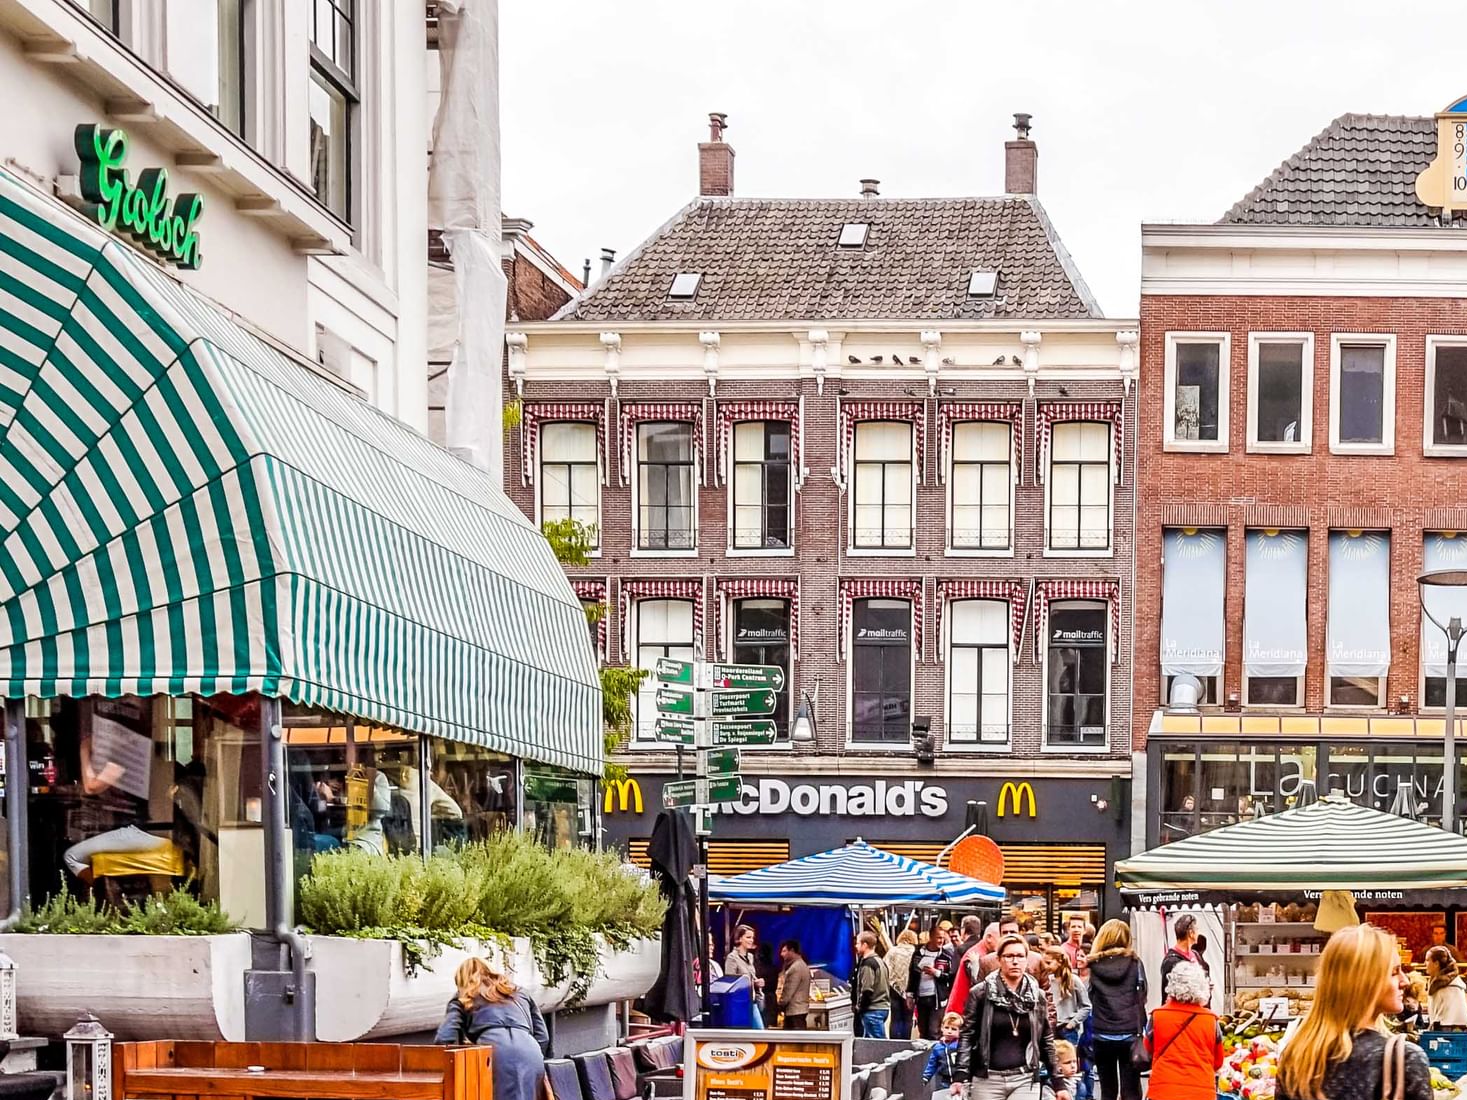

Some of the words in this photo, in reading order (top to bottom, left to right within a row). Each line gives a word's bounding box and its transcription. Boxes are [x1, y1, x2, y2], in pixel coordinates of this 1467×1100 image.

[1455, 124, 1465, 139] 8
[1454, 143, 1465, 160] 9
[1453, 176, 1467, 191] 10
[92, 122, 204, 270] Grolsch
[747, 629, 788, 639] mailtraffic
[867, 629, 908, 639] mailtraffic
[1062, 630, 1104, 640] mailtraffic
[1250, 746, 1304, 797] La
[1138, 893, 1152, 904] Vers
[1152, 892, 1181, 904] gebrande
[1181, 891, 1199, 901] noten
[1375, 890, 1403, 900] noten
